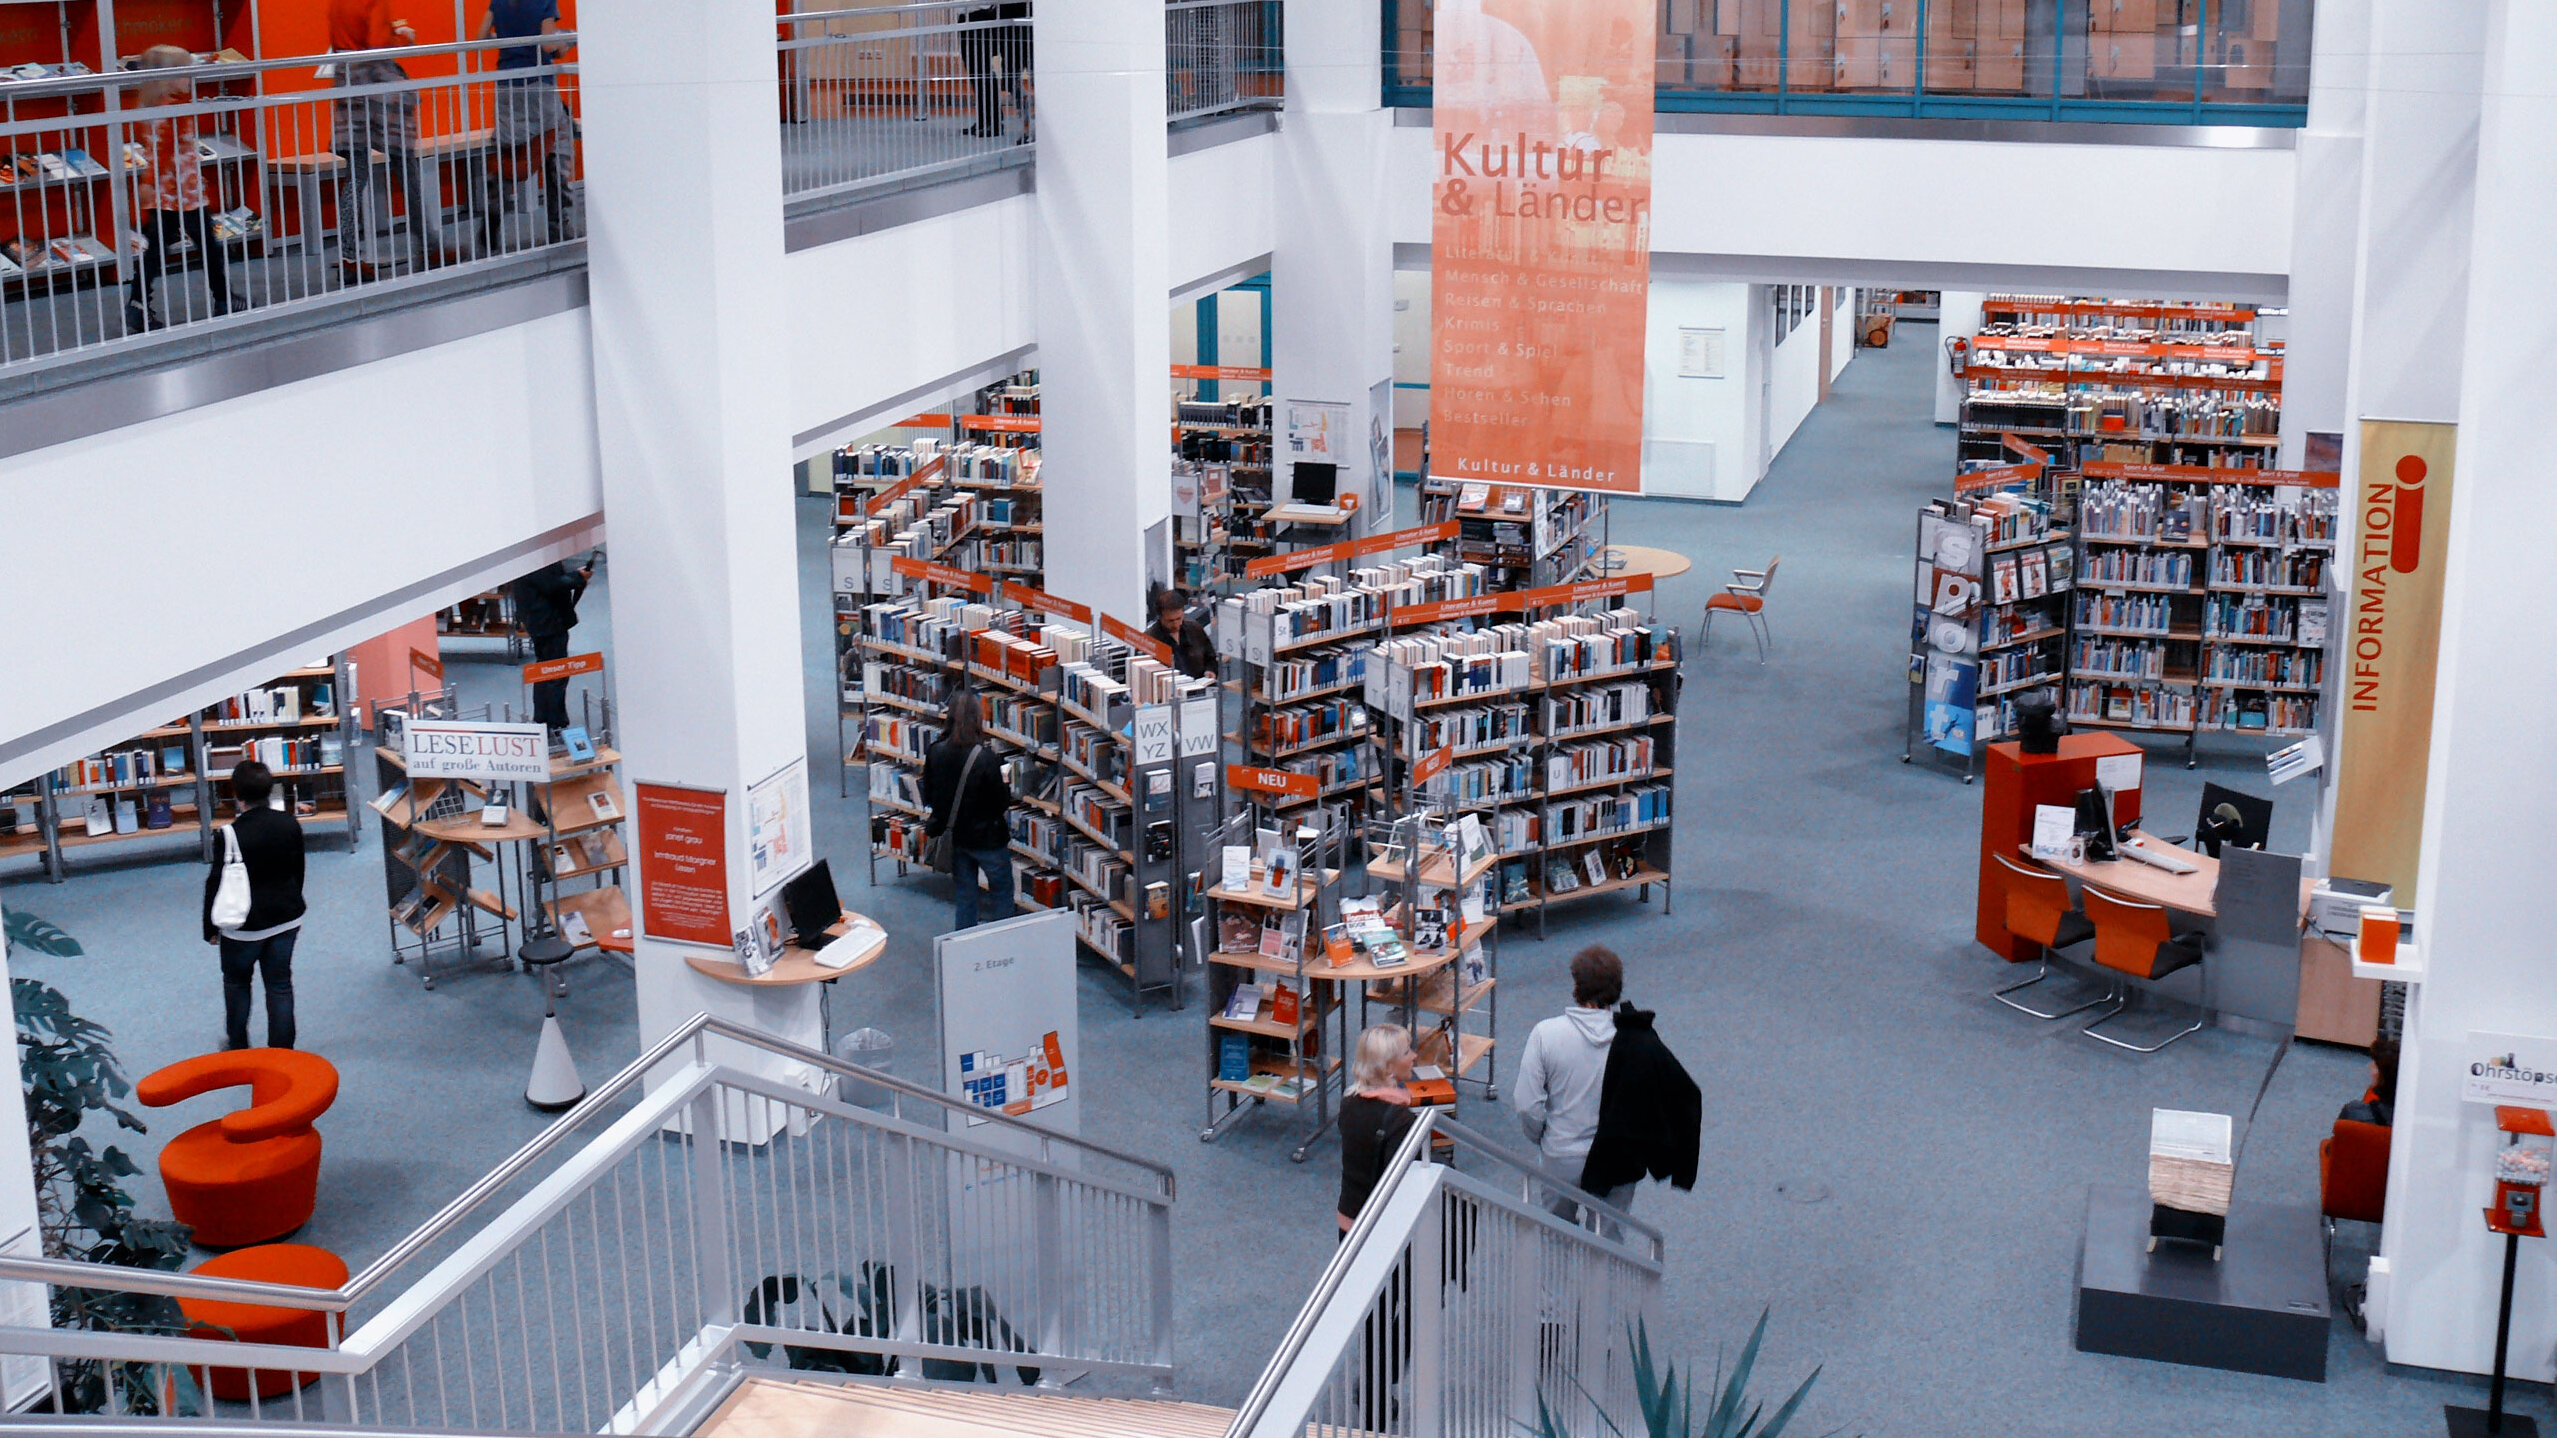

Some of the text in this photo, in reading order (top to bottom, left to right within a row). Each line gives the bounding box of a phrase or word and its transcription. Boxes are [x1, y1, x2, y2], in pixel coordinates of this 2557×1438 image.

[1444, 132, 1612, 182] Kultur
[1440, 178, 1646, 224] & Länder
[1445, 269, 1643, 295] Mensch & Gesellschaft
[1445, 293, 1607, 313] Reisen & Sprachen
[1445, 317, 1500, 332] Krimis
[1444, 339, 1557, 359] Sport & Spiel
[1445, 363, 1494, 378] Trend
[1444, 410, 1527, 426] Bestseller
[1458, 457, 1616, 483] Kultur & Länder
[844, 577, 854, 589] S
[883, 579, 892, 591] S
[2353, 483, 2394, 711] INFORMATION
[1226, 639, 1235, 652] S
[567, 659, 587, 671] Tipp
[1139, 721, 1169, 739] WX
[1143, 743, 1167, 760] YZ
[1185, 734, 1214, 752] VW
[413, 757, 541, 773] auf große Autoren
[1257, 772, 1287, 787] NEU
[1553, 769, 1560, 779] U
[973, 955, 1015, 972] 2. Etage
[2471, 1060, 2557, 1086] Ohrstöps
